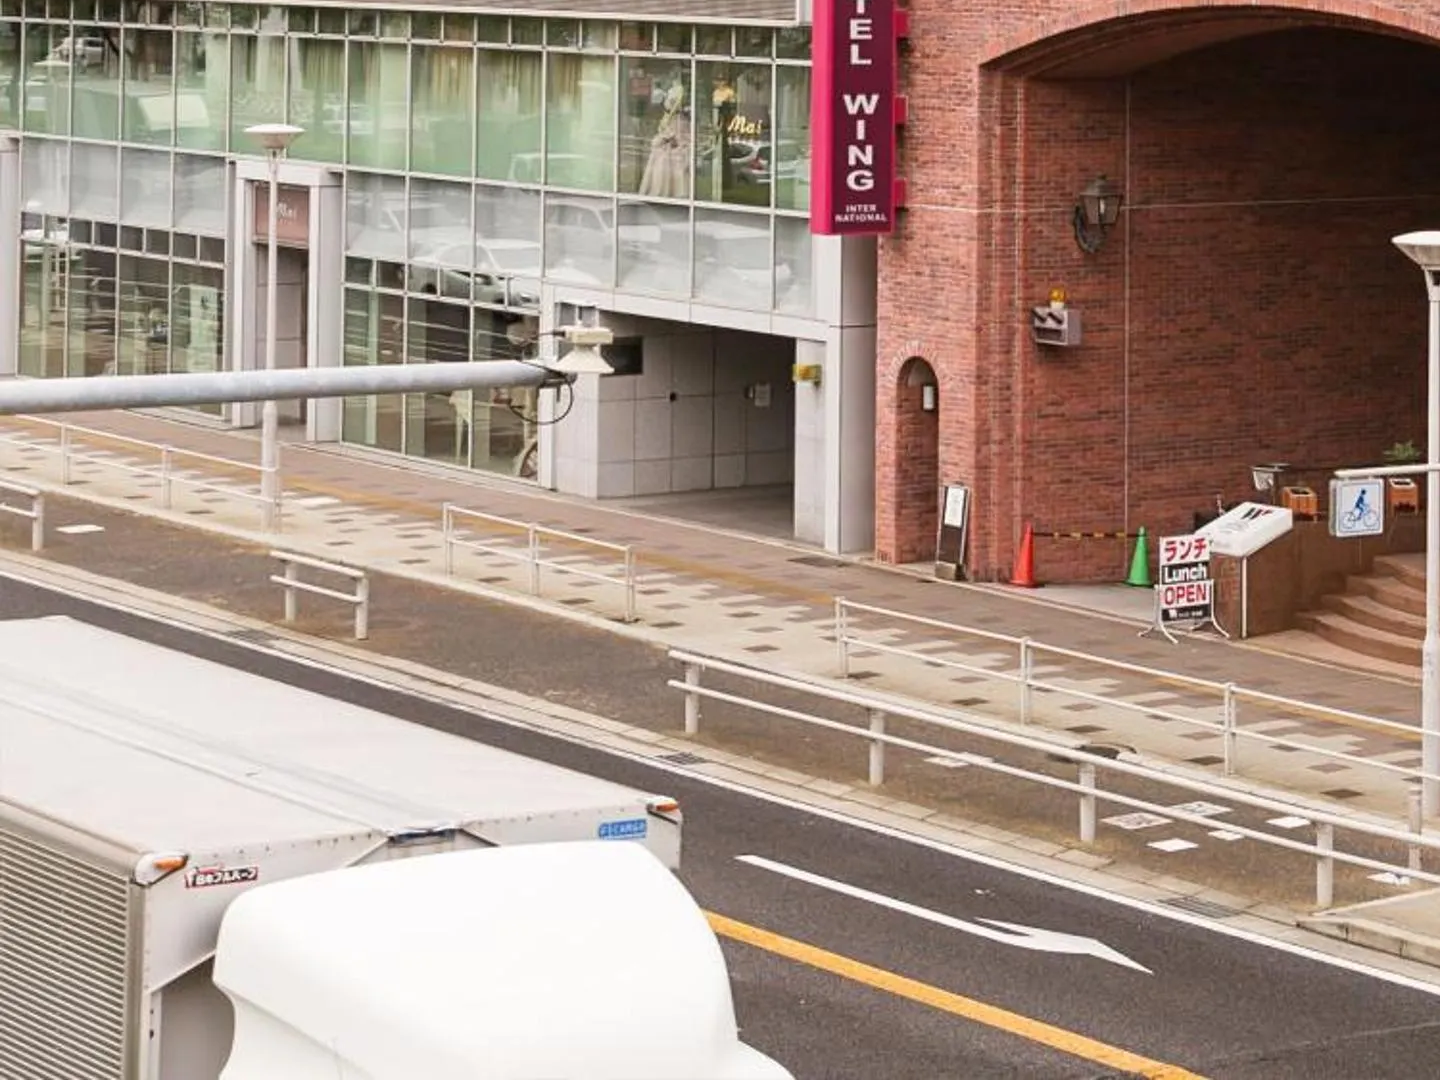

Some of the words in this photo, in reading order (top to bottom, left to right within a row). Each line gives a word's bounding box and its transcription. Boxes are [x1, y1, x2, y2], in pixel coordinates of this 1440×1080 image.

[843, 94, 879, 191] WING
[834, 213, 887, 222] NATIONAL
[846, 204, 876, 212] INTER
[1164, 538, 1207, 562] ランチ
[1164, 565, 1207, 583] Lunch
[1164, 585, 1207, 606] OPEN
